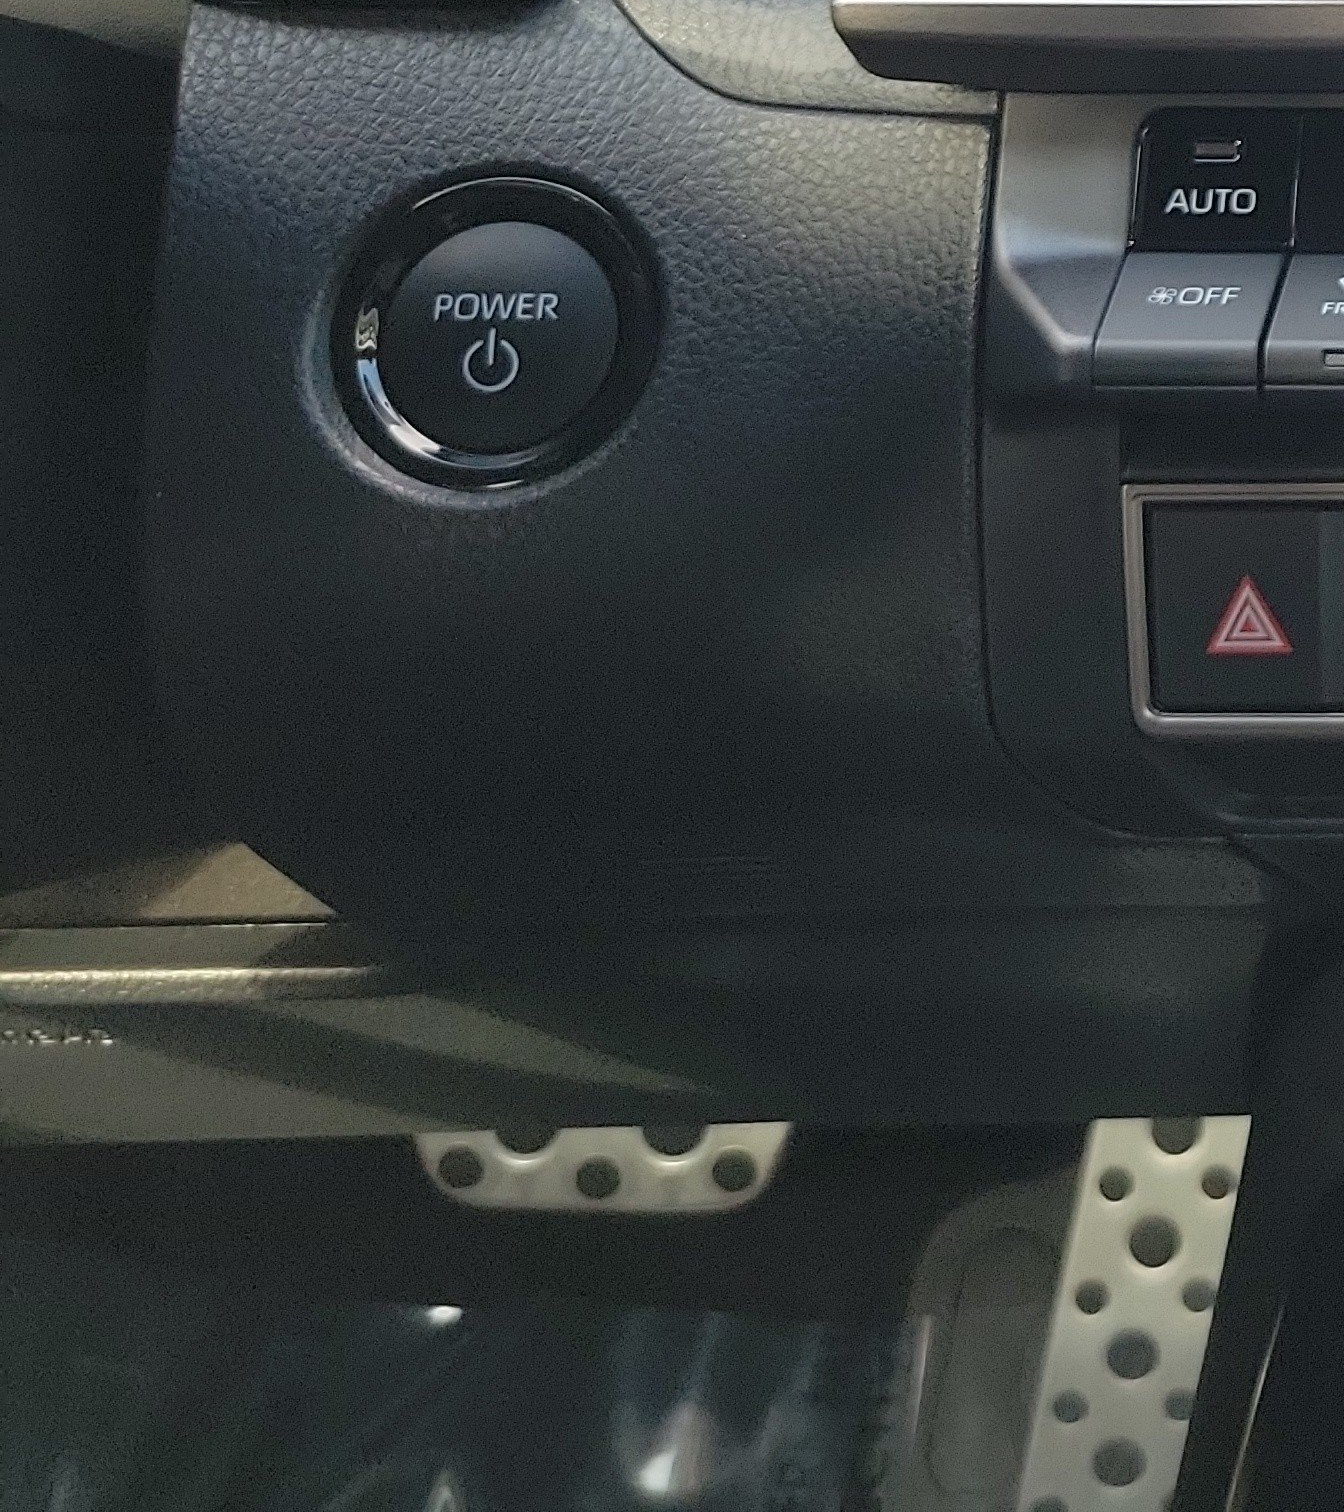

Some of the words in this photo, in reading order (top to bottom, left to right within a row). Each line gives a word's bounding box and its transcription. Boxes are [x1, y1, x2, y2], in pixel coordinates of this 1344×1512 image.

[1164, 188, 1257, 216] AUTO
[433, 292, 560, 322] POWER
[1177, 286, 1242, 306] OFF
